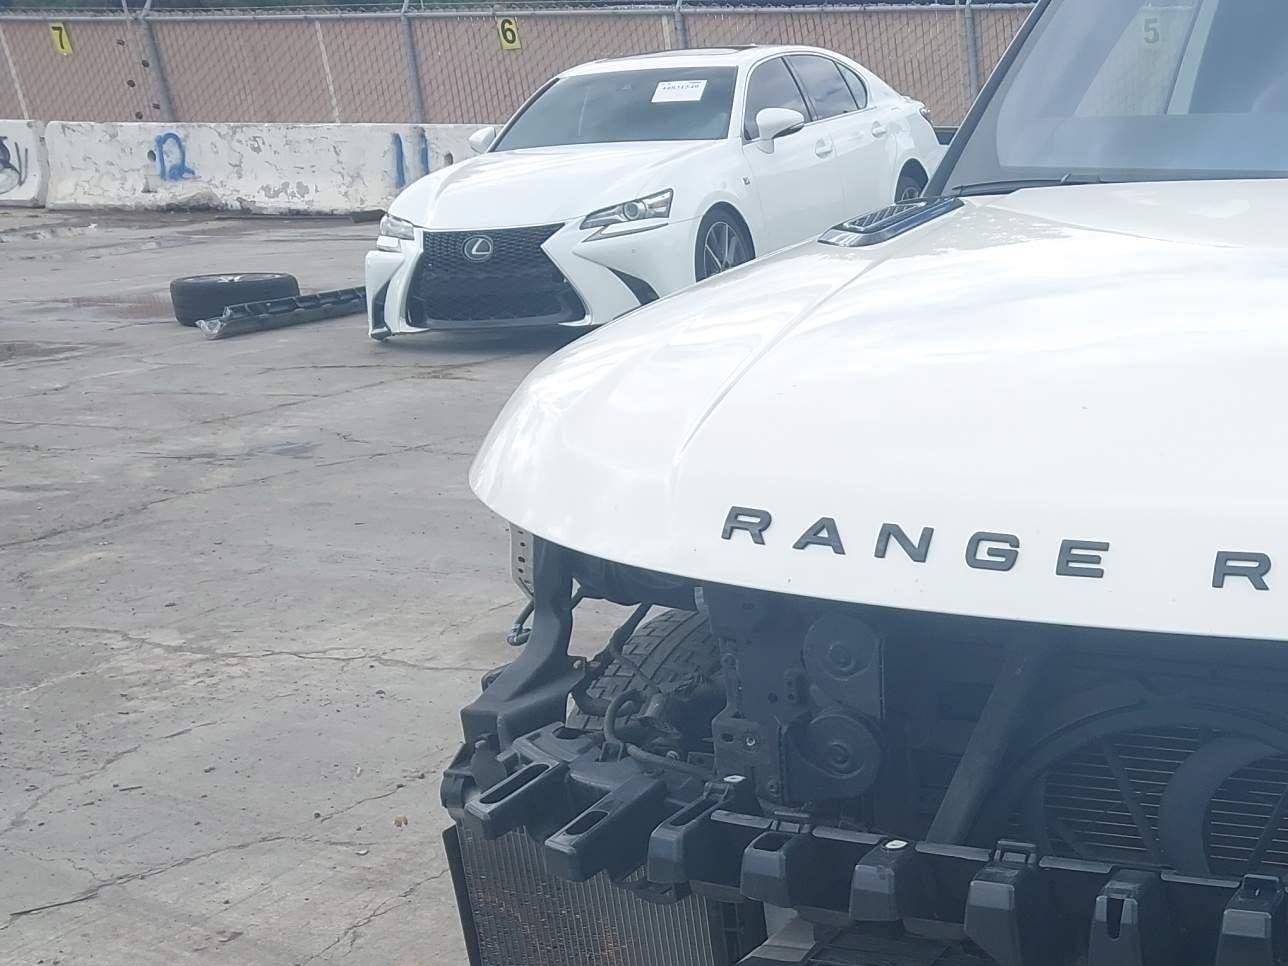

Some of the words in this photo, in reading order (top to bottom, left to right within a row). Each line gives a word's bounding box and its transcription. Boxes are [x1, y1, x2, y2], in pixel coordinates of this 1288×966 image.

[51, 26, 65, 50] 7
[500, 18, 517, 44] 6
[1143, 18, 1160, 44] 5
[721, 506, 1110, 578] RANGE
